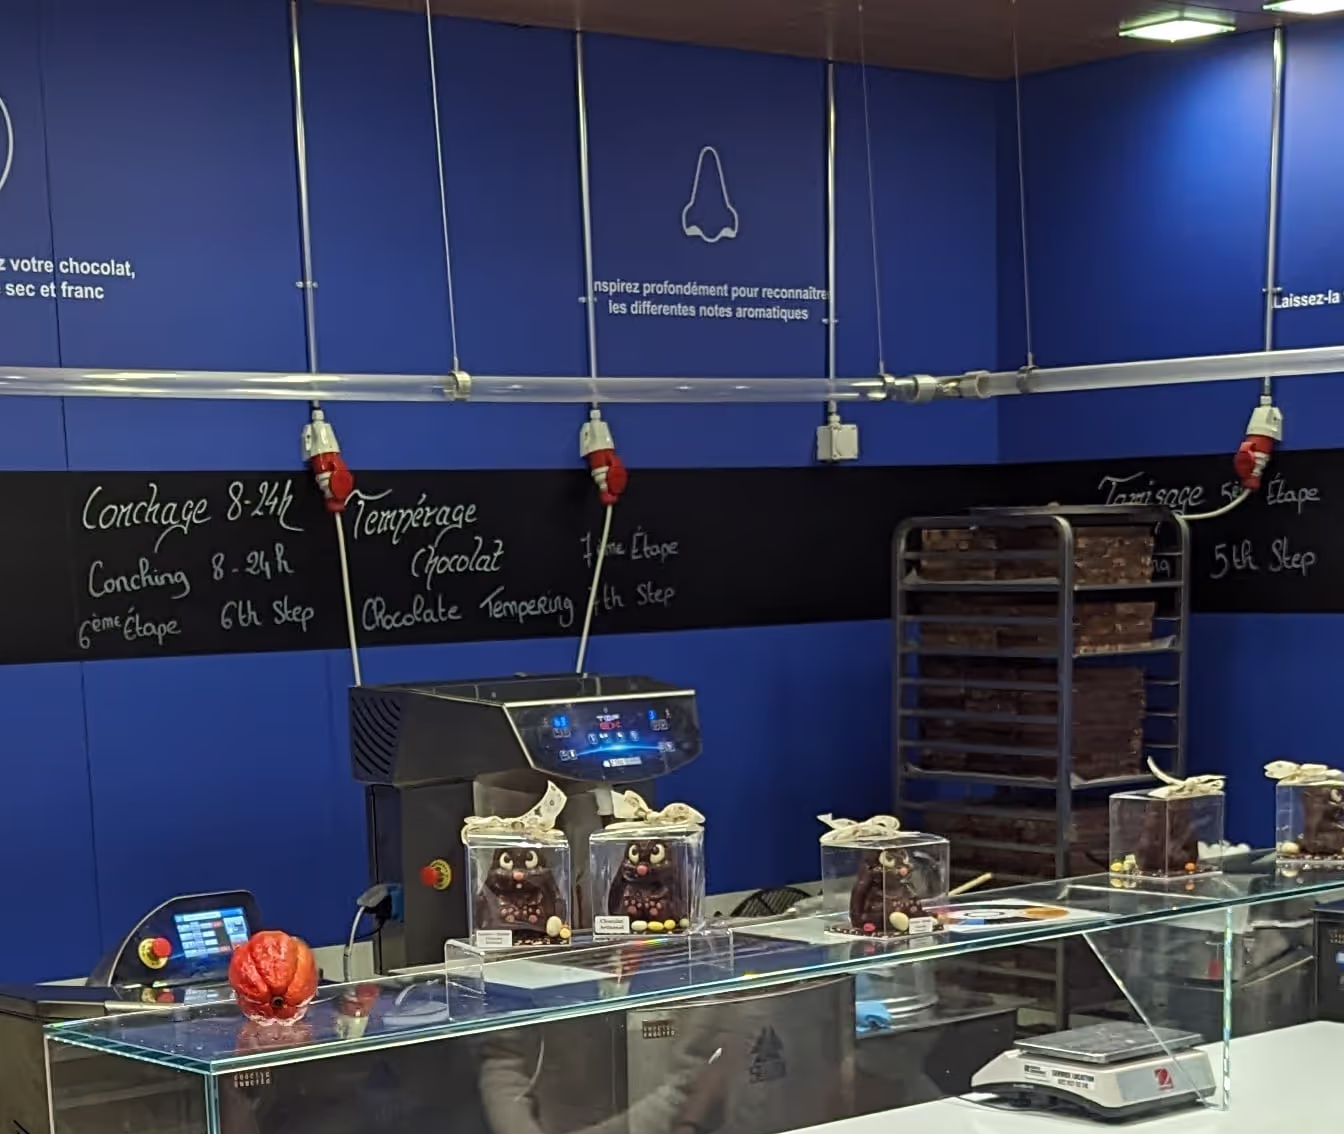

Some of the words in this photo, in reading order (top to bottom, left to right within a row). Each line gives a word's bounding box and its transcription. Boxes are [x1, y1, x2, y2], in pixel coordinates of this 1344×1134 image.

[10, 256, 53, 273] votre
[59, 257, 136, 278] chocolat,
[5, 282, 35, 297] sec
[40, 282, 57, 298] et
[61, 281, 105, 300] franc
[593, 278, 639, 296] nspirez
[643, 281, 729, 299] profondément
[731, 285, 759, 301] pour
[1272, 291, 1341, 309] Laissez-la
[608, 300, 627, 315] les
[699, 304, 733, 318] notes
[736, 305, 808, 323] aromatiques
[88, 557, 191, 600] Conching
[272, 595, 314, 632] Step
[361, 593, 463, 631] Chocolate
